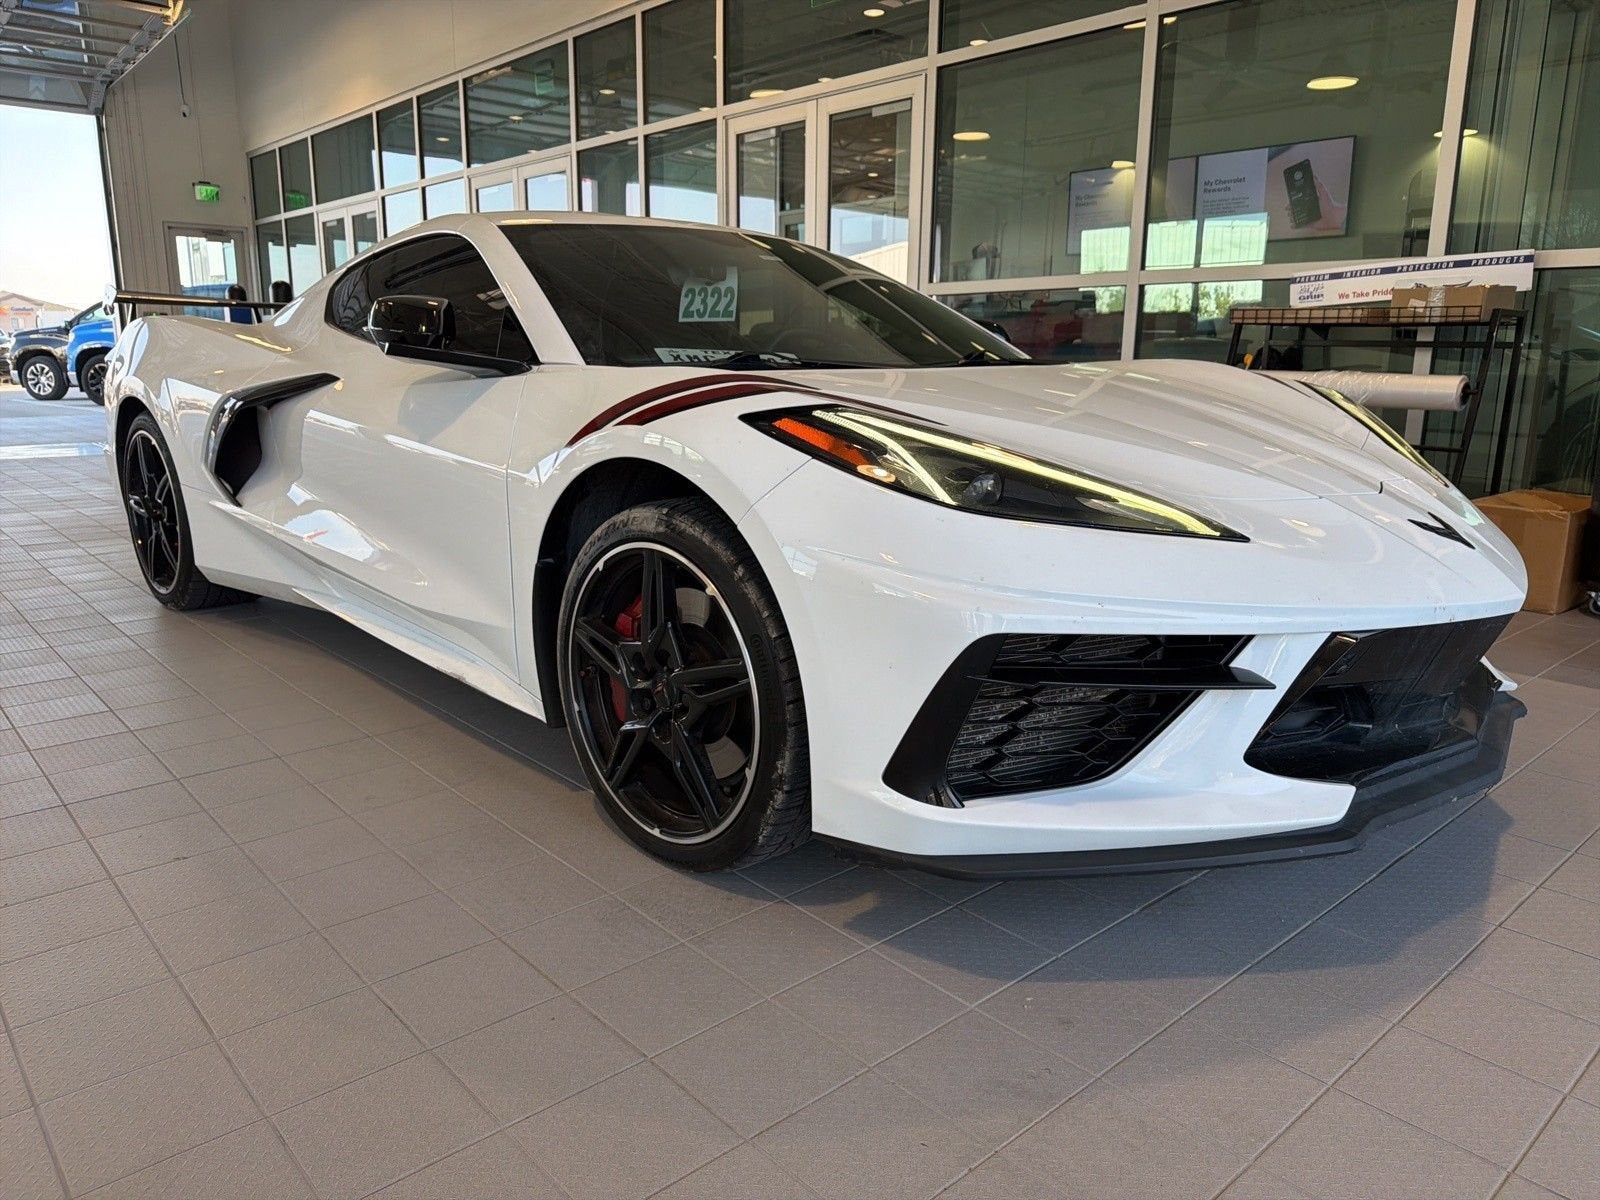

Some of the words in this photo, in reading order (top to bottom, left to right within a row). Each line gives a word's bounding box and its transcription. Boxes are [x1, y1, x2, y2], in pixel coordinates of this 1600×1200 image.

[1214, 176, 1246, 186] Chevrolet
[1295, 273, 1330, 284] PREMIUM
[1342, 268, 1381, 279] INTERIOR
[1396, 261, 1455, 273] PROTECTION
[1471, 255, 1525, 266] PRODUCTS
[681, 286, 735, 319] 2322
[1337, 291, 1350, 300] We
[1352, 290, 1370, 299] Take
